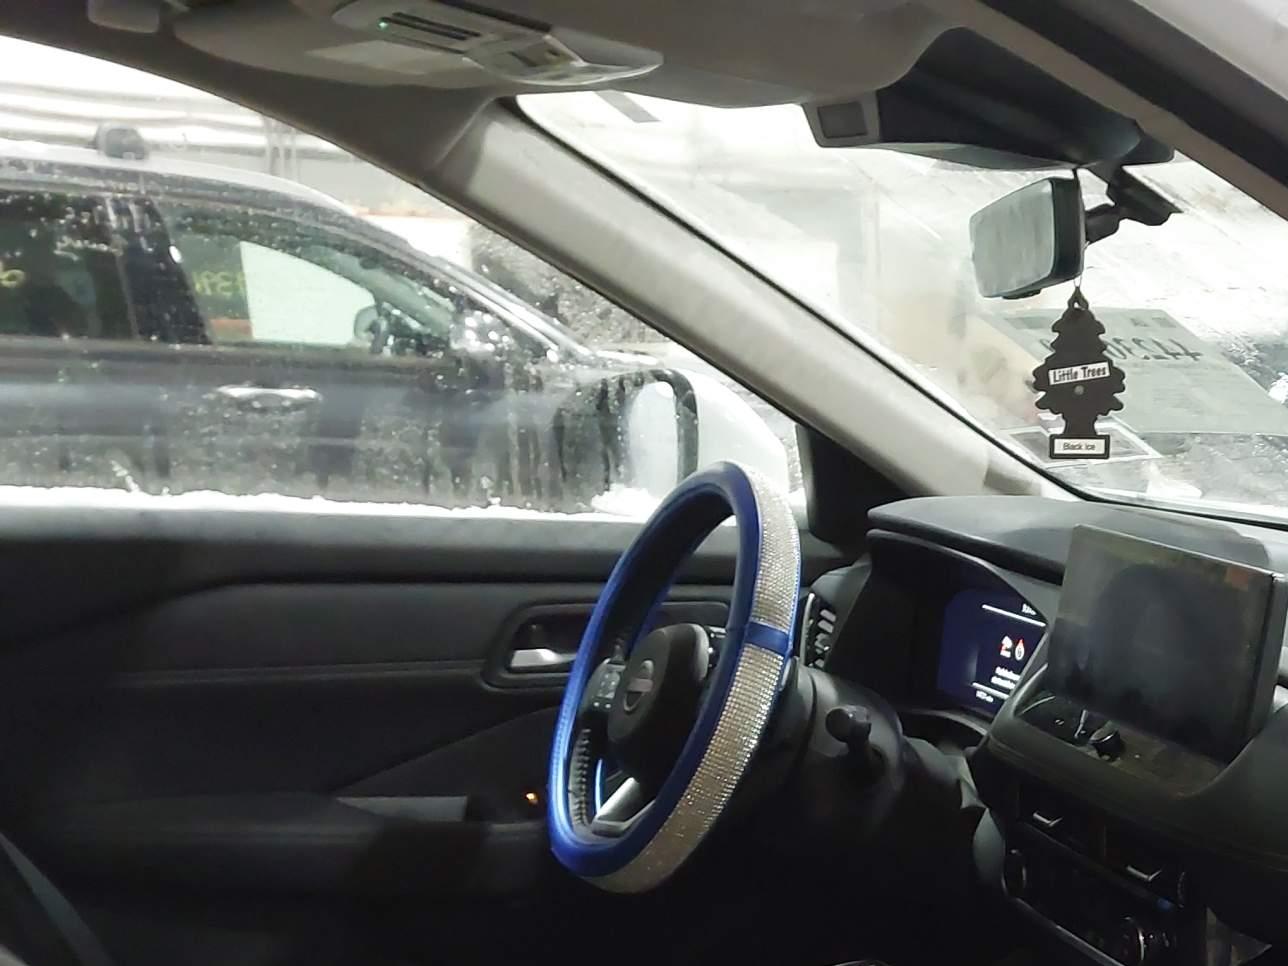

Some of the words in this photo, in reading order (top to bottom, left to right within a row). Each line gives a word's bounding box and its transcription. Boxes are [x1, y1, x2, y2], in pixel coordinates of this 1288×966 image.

[1053, 367, 1079, 384] Little
[1081, 365, 1106, 379] Trees
[1062, 442, 1083, 451] Black
